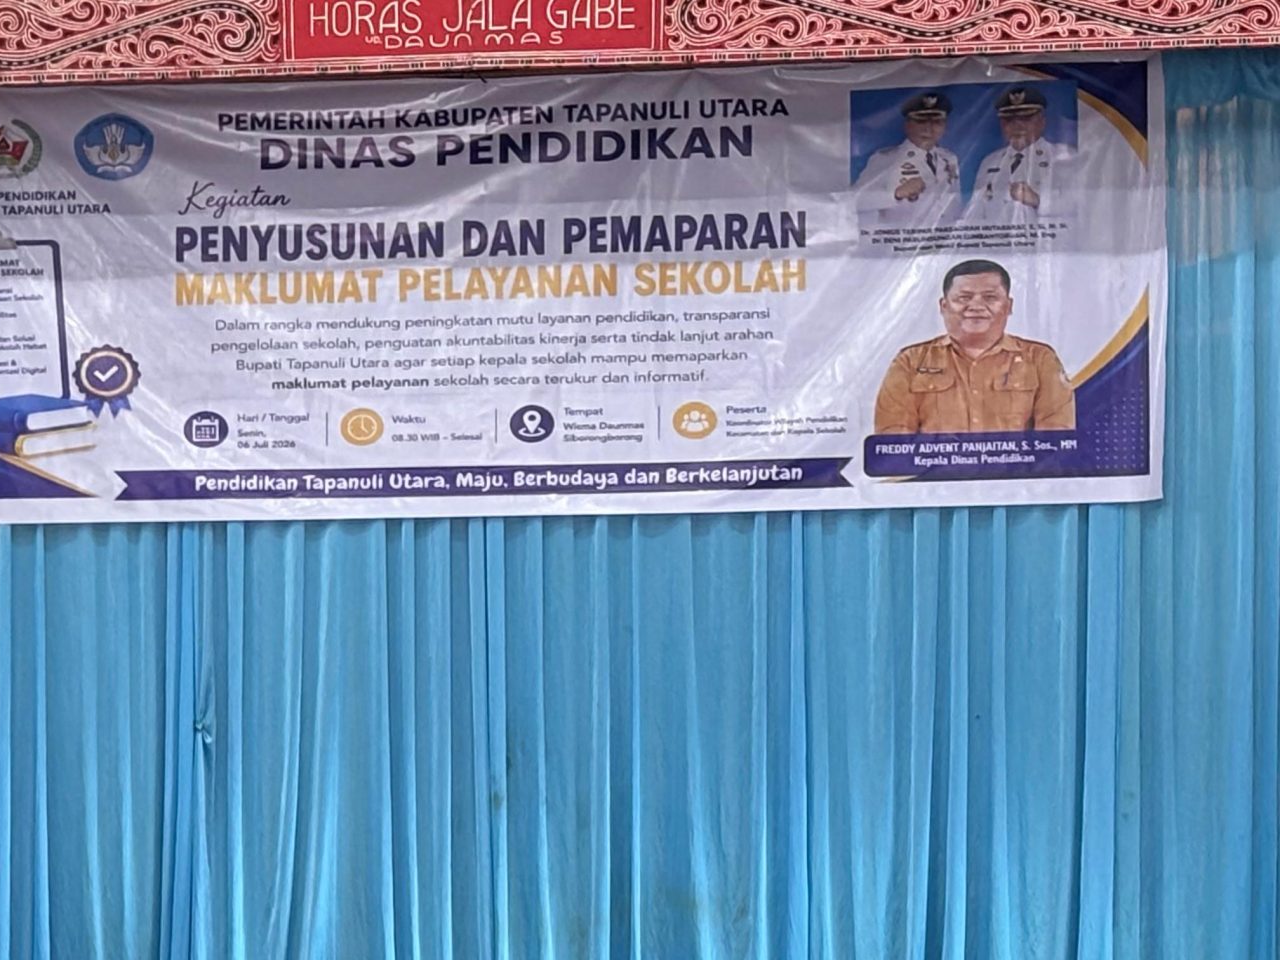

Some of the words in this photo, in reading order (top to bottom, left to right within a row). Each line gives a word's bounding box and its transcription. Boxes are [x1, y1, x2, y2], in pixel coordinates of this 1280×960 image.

[309, 0, 422, 37] HORAS
[442, 0, 532, 33] JALA
[546, 0, 636, 30] GABE
[384, 33, 473, 50] DAUN
[218, 110, 385, 132] PEMERINTAH
[395, 105, 553, 129] KABUPATEN
[562, 100, 689, 124] TAPANULI
[699, 98, 790, 119] UTARA
[259, 135, 416, 170] DINAS
[436, 124, 753, 166] PENDIDIKAN
[1, 204, 64, 216] TAPANULI
[66, 203, 112, 215] UTARA
[178, 180, 291, 219] Kegiatan
[175, 221, 445, 263] PENYUSUNAN
[463, 218, 545, 258] DAN
[563, 210, 807, 255] PEMAPARAN
[0, 268, 45, 277] SEKOLAH
[175, 267, 384, 307] MAKLUMAT
[399, 262, 618, 303] PELAYANAN
[633, 258, 807, 298] SEKOLAH
[215, 319, 261, 332] Dalam
[264, 319, 312, 335] rangka
[316, 317, 401, 334] mendukung
[404, 315, 493, 332] peningkatan
[496, 314, 534, 326] mutu
[537, 312, 592, 328] layanan
[595, 310, 680, 327] pendidikan,
[683, 307, 771, 324] transparansi
[210, 338, 299, 354] pengelolaan
[302, 337, 361, 351] sekolah,
[364, 337, 442, 351] penguatan
[446, 333, 536, 347] akuntabilitas
[539, 331, 587, 348] kinerja
[590, 333, 627, 345] serta
[631, 330, 676, 343] tindak
[680, 328, 721, 346] lanjut
[723, 328, 774, 341] arahan
[235, 357, 282, 372] Bupati
[286, 357, 346, 372] Tapanuli
[350, 356, 390, 370] Utara
[393, 357, 426, 371] agar
[430, 354, 476, 370] setiap
[478, 352, 528, 367] kepala
[531, 351, 587, 366] sekolah
[590, 353, 648, 368] mampu
[651, 349, 749, 365] memaparkan
[271, 377, 347, 391] maklumat
[351, 376, 430, 393] pelayanan
[433, 374, 490, 388] sekolah
[493, 375, 541, 386] secara
[544, 373, 598, 385] terukur
[601, 370, 630, 384] dan
[633, 369, 710, 384] informatif.
[237, 412, 259, 422] Hari
[268, 411, 310, 424] Tanggal
[391, 414, 427, 425] Waktu
[563, 406, 604, 418] Tempat
[726, 405, 767, 414] Peserta
[236, 440, 250, 449] 06
[252, 440, 269, 449] Juli
[271, 439, 296, 449] 2026
[391, 433, 419, 442] 08.30
[419, 432, 440, 442] WIB
[875, 444, 916, 455] FREDDY
[919, 443, 960, 453] ADVENT
[962, 441, 1019, 453] PANJAITAN,
[914, 455, 949, 468] Kepala
[951, 454, 978, 465] Dinas
[980, 453, 1036, 464] Pendidikan
[194, 474, 298, 493] Pendidikan
[302, 474, 384, 497] Tapanuli
[513, 469, 619, 490] Berbudaya
[624, 468, 660, 485] dan
[665, 466, 803, 486] Berkelanjutan
